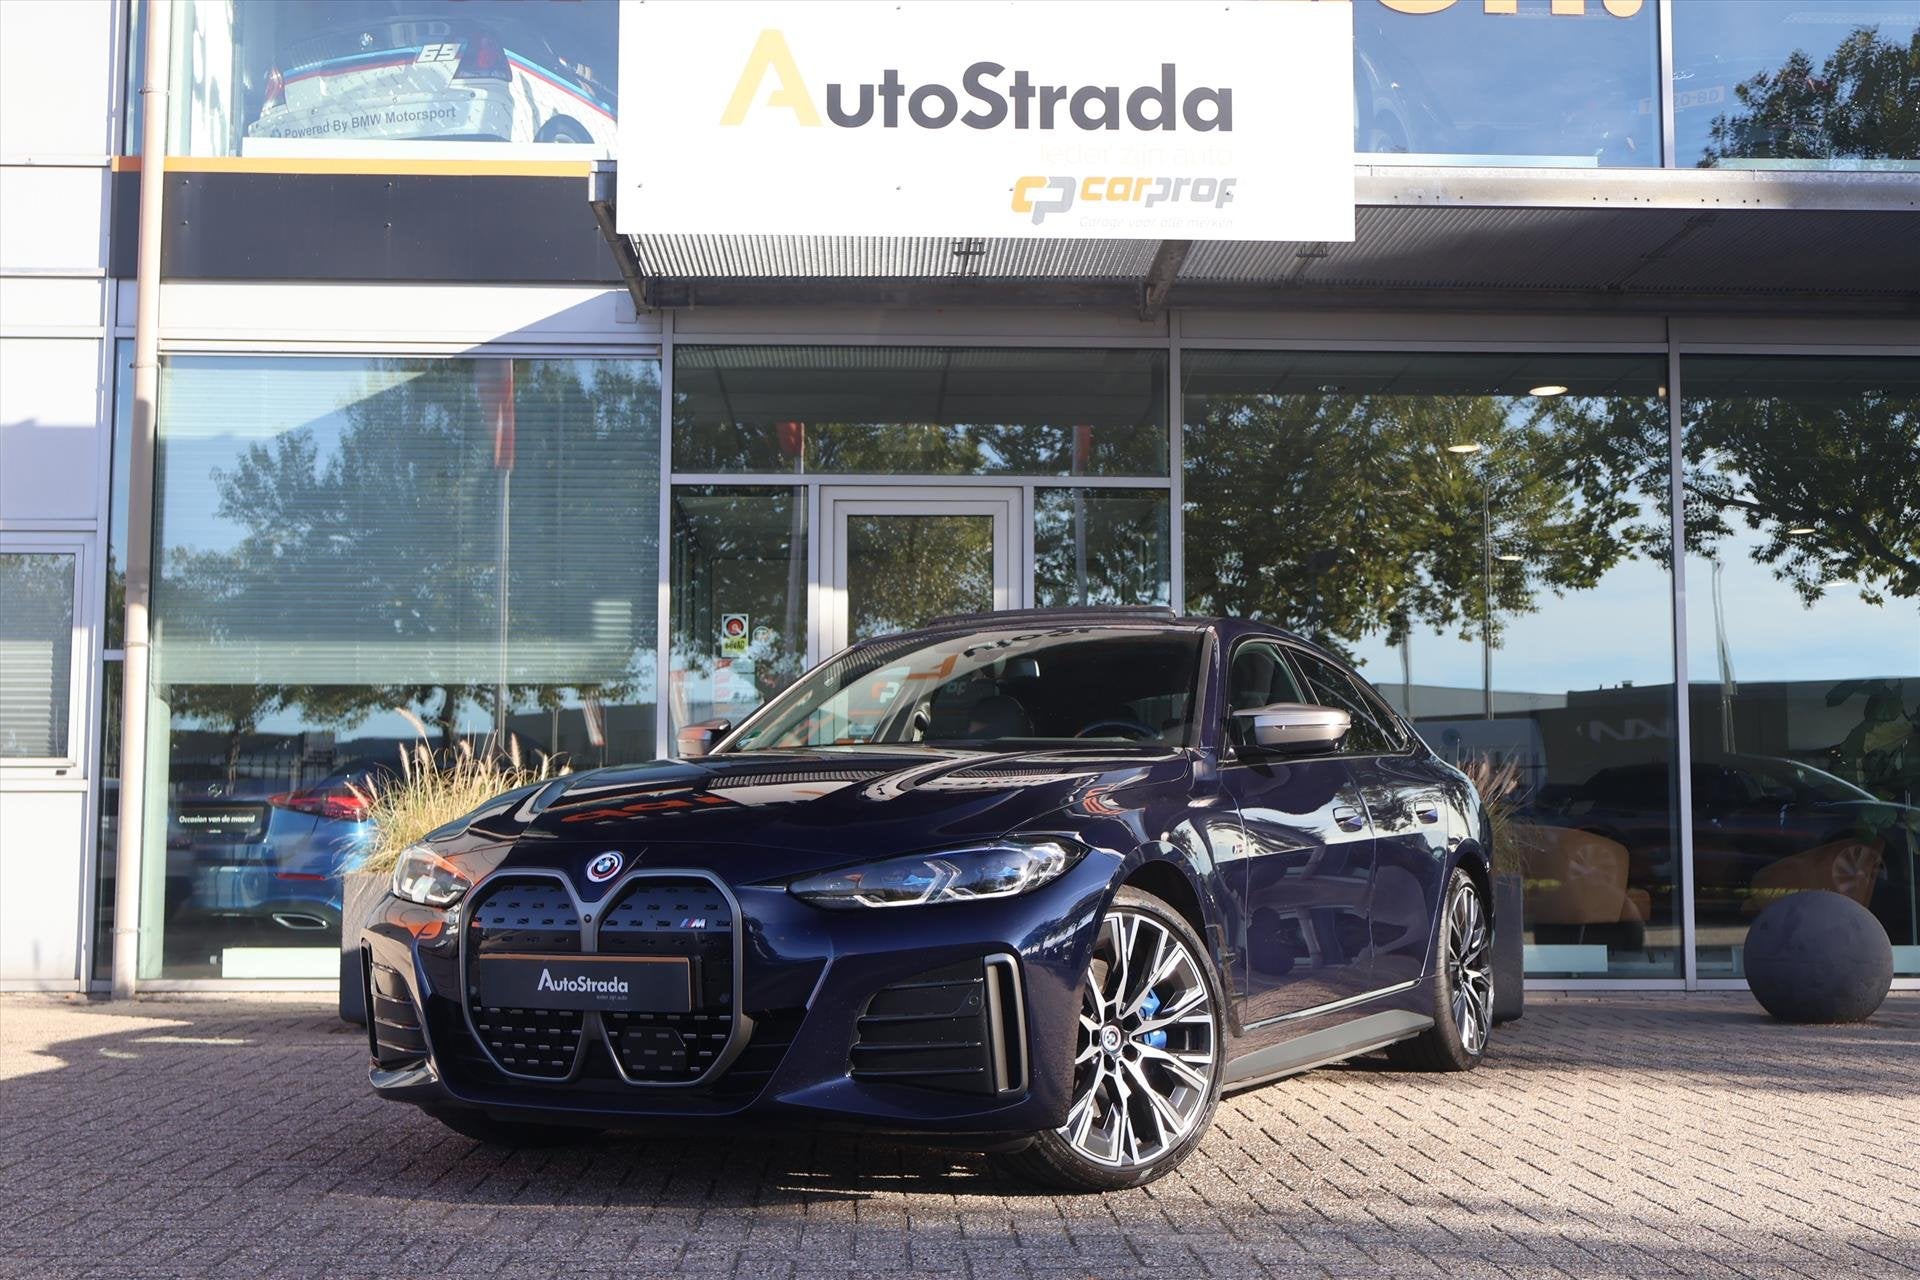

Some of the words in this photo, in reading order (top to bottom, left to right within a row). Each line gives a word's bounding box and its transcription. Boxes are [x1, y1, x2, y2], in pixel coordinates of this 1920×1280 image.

[419, 43, 459, 63] 69
[718, 27, 1233, 132] AutoStrada
[284, 121, 330, 138] Powered
[333, 119, 348, 133] By
[352, 113, 382, 129] BMW
[385, 106, 456, 123] Motorsport
[178, 814, 207, 823] Occasion
[221, 814, 230, 823] de
[231, 814, 256, 823] maand
[537, 968, 629, 994] AutoStrada
